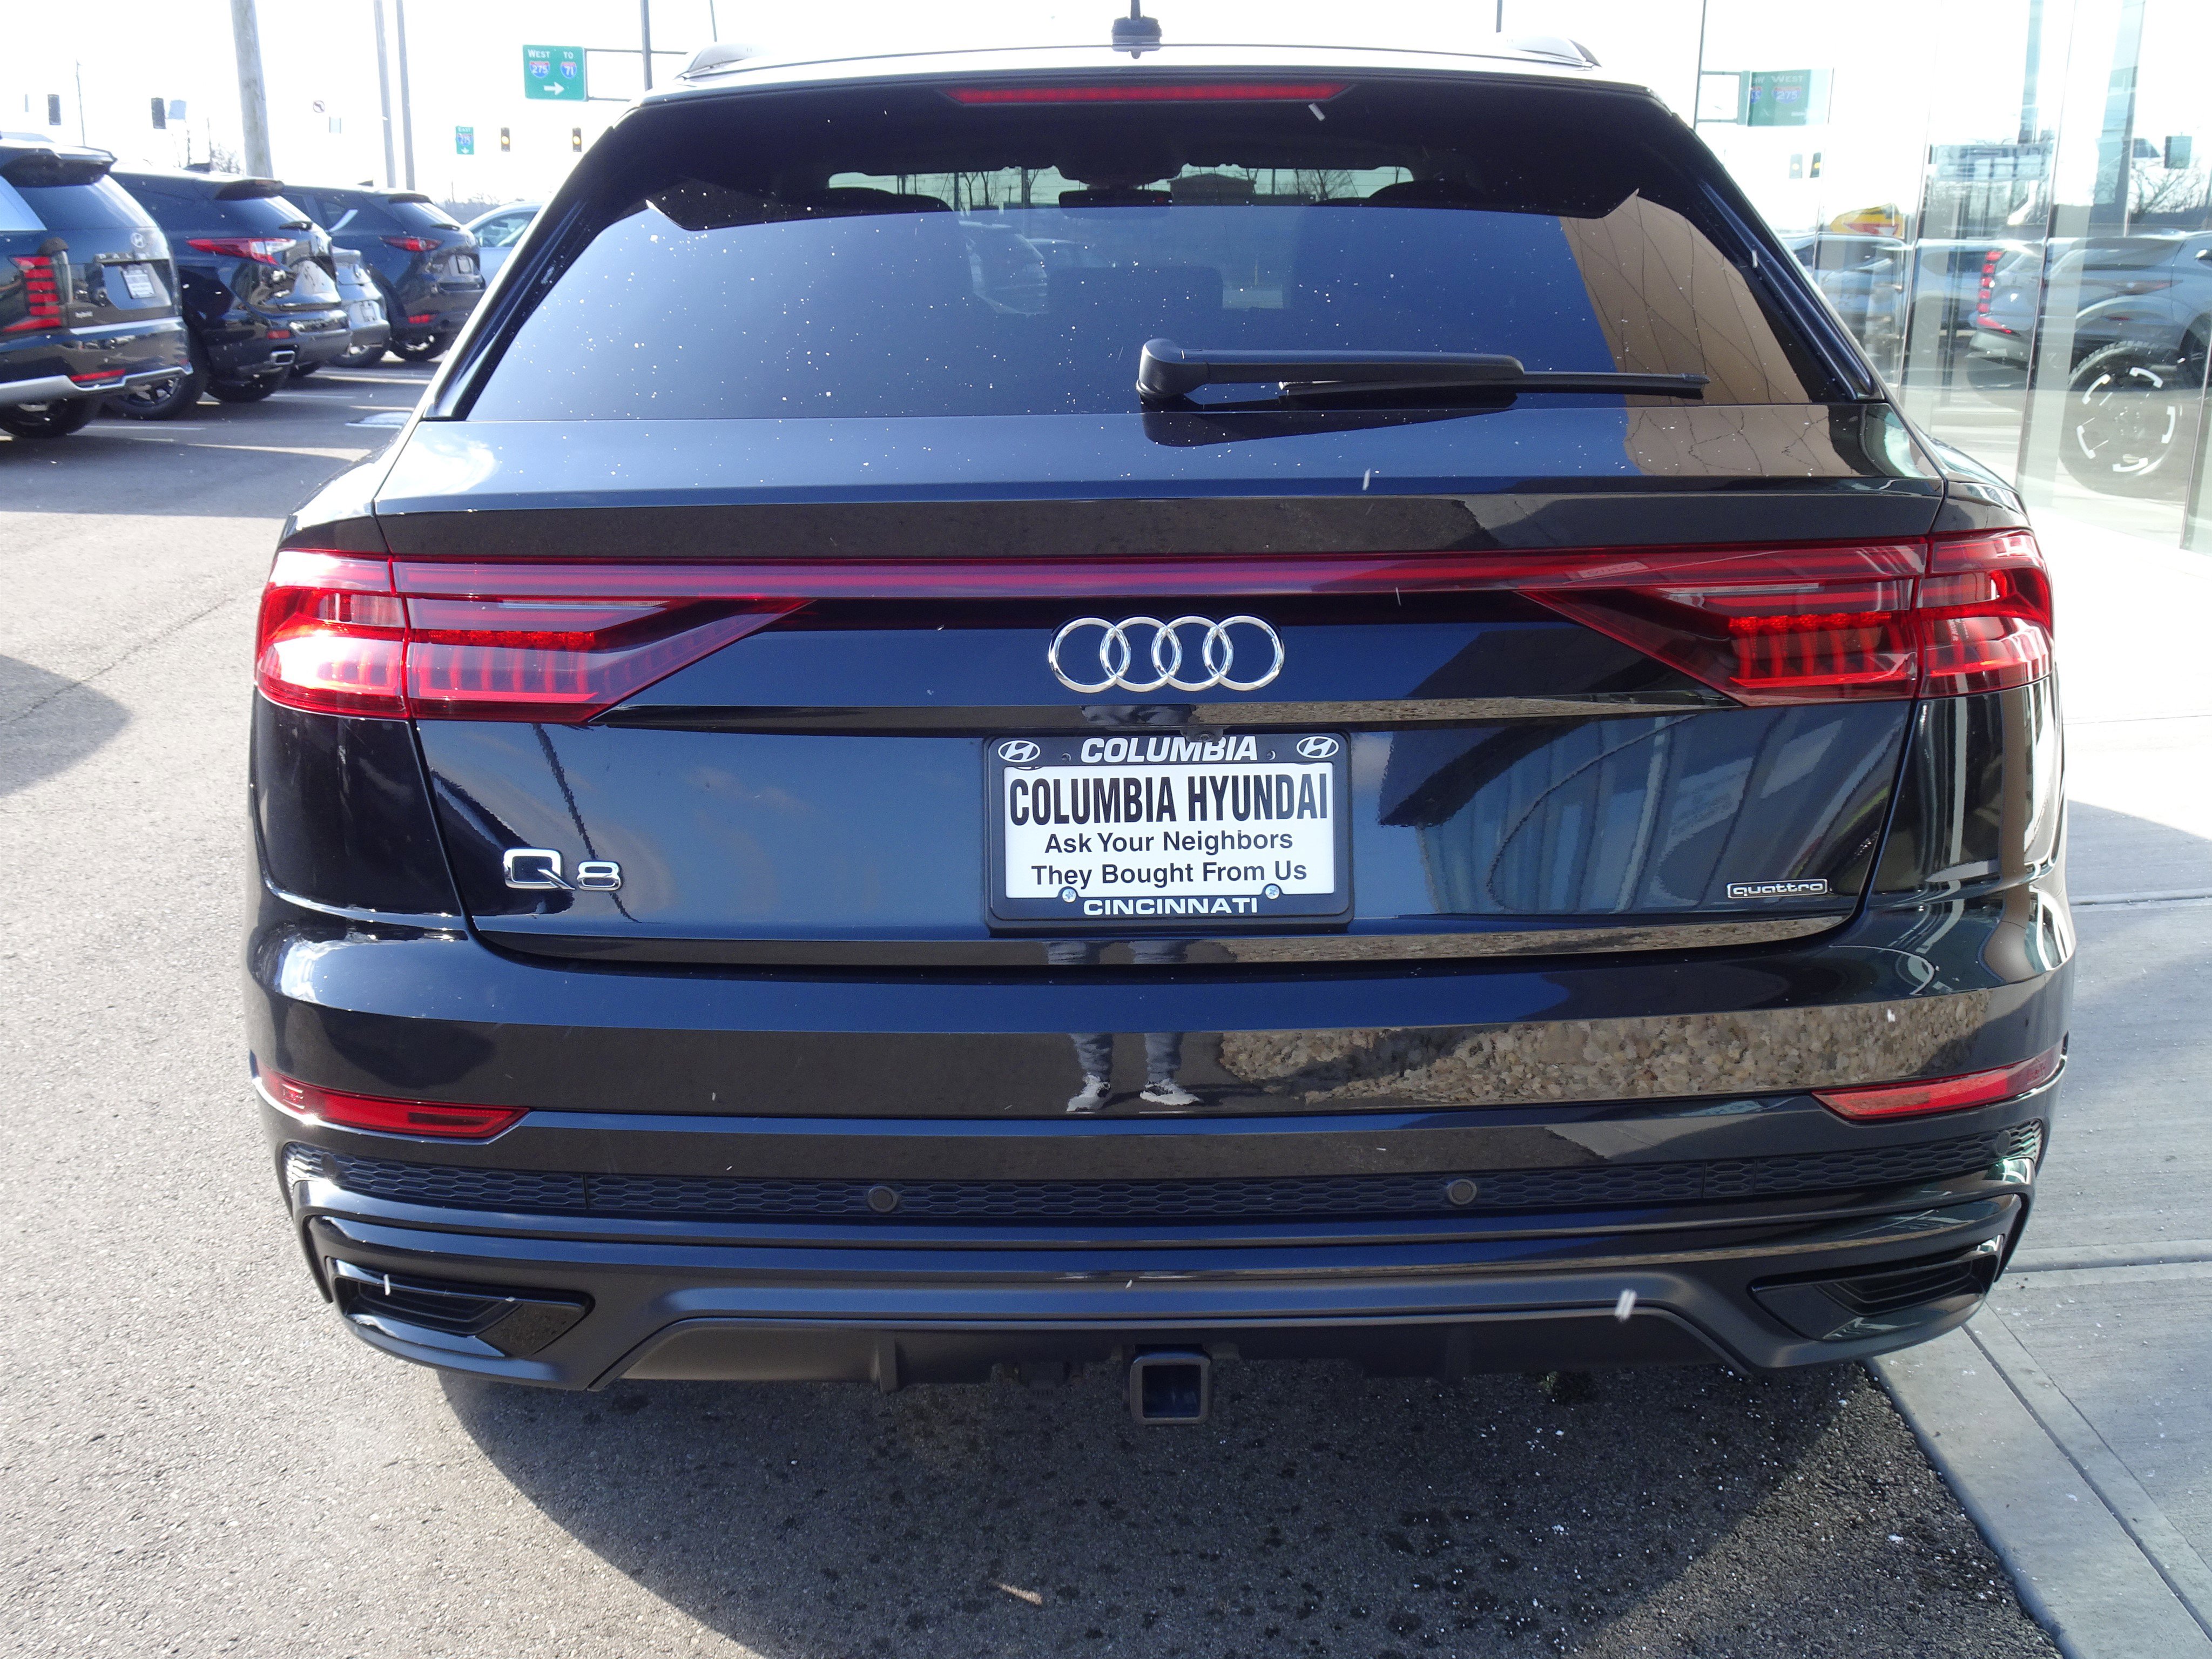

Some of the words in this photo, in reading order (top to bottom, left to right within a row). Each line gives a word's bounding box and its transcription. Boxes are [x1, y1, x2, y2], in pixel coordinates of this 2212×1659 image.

[528, 49, 550, 58] WEST
[532, 65, 548, 73] 275
[565, 66, 574, 75] 71
[1778, 91, 1797, 99] 275
[1081, 736, 1258, 763] COLUMBIA
[1010, 777, 1177, 826] COLUMBIA
[1188, 773, 1328, 821] HYUNDAI
[1045, 833, 1092, 853] Ask
[1098, 833, 1155, 853] Your
[1164, 830, 1293, 855] Neighbors
[1031, 865, 1092, 889] They
[1102, 862, 1193, 887] Bought
[1203, 861, 1265, 881] From
[1274, 861, 1307, 880] Us
[1733, 883, 1823, 896] quattro
[1084, 898, 1258, 915] CINCINNATI
